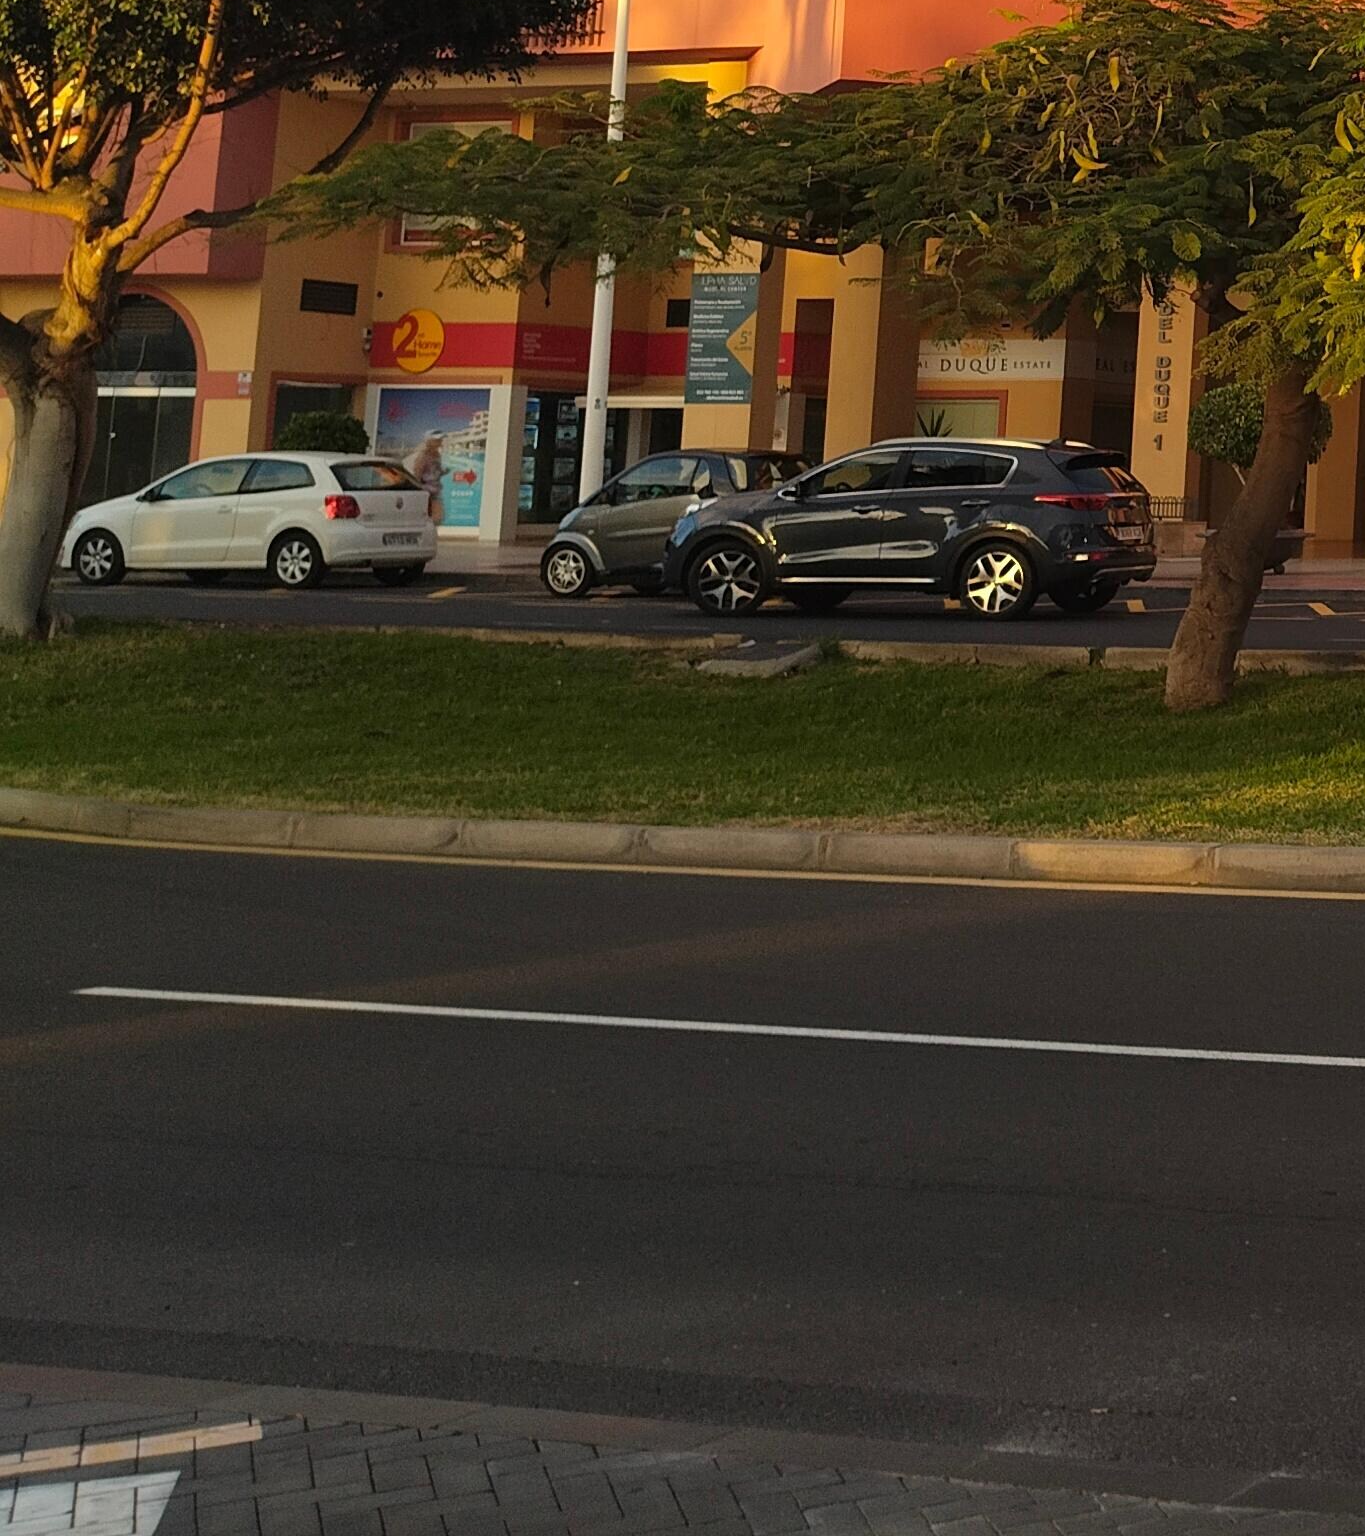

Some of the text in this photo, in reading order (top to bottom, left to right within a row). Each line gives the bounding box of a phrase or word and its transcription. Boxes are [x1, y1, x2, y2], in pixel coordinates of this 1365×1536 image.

[940, 358, 1008, 374] DUQUE
[1153, 355, 1172, 424] DUQUE
[1152, 433, 1163, 451] 1
